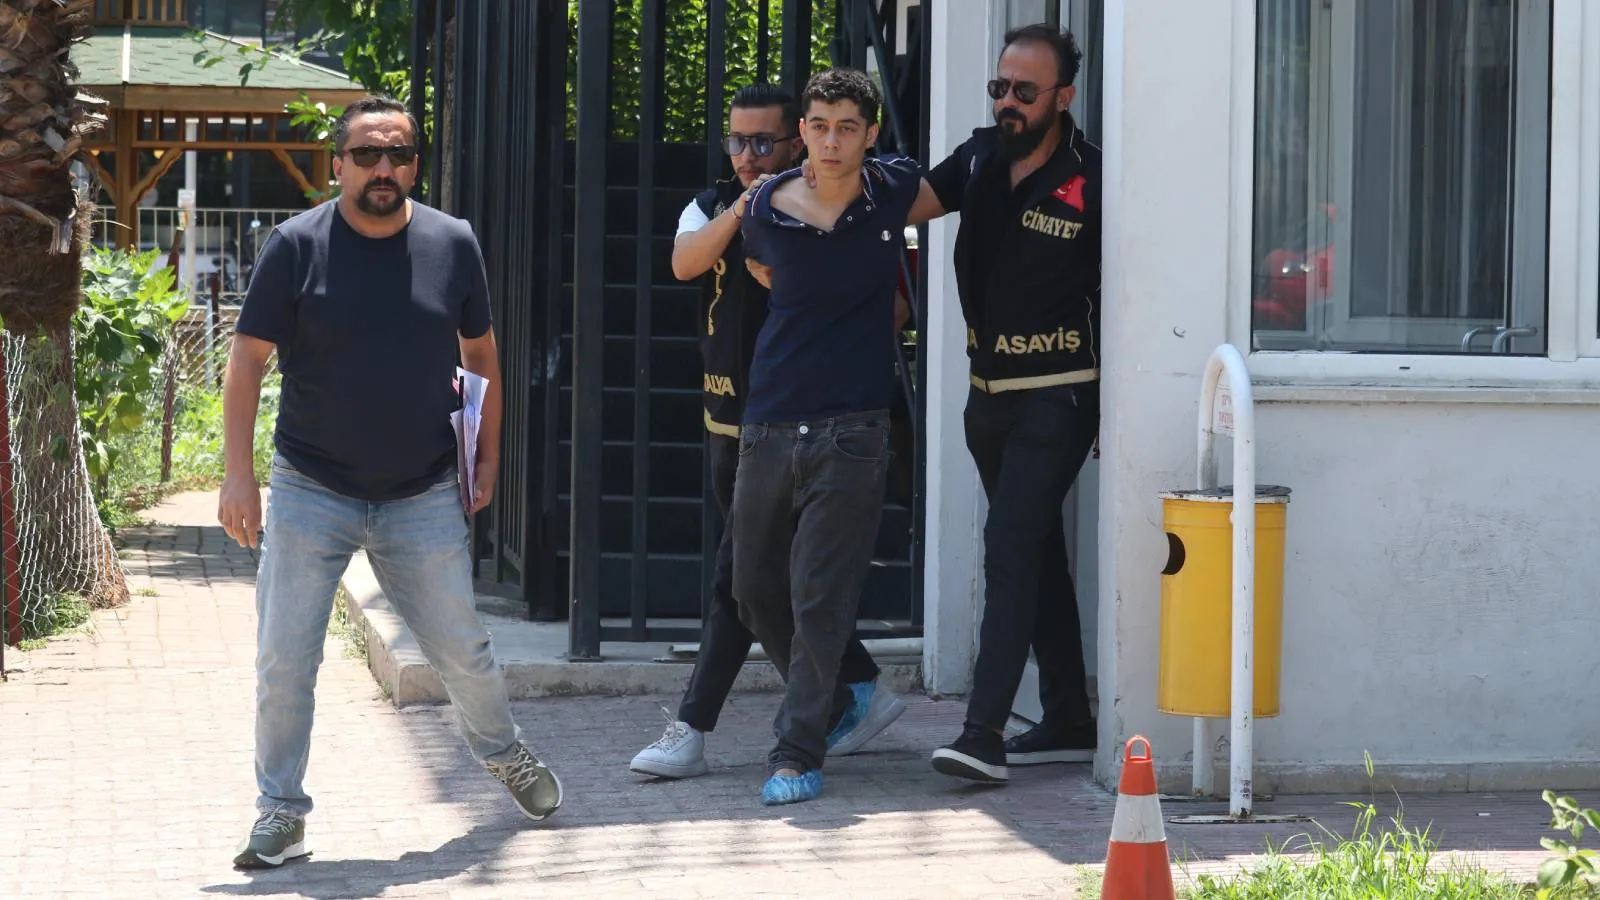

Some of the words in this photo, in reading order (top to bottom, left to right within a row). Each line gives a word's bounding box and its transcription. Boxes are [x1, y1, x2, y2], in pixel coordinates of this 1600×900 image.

[1022, 206, 1083, 239] CİNAYET
[994, 326, 1081, 354] ASAYİŞ
[704, 372, 737, 397] ALYA
